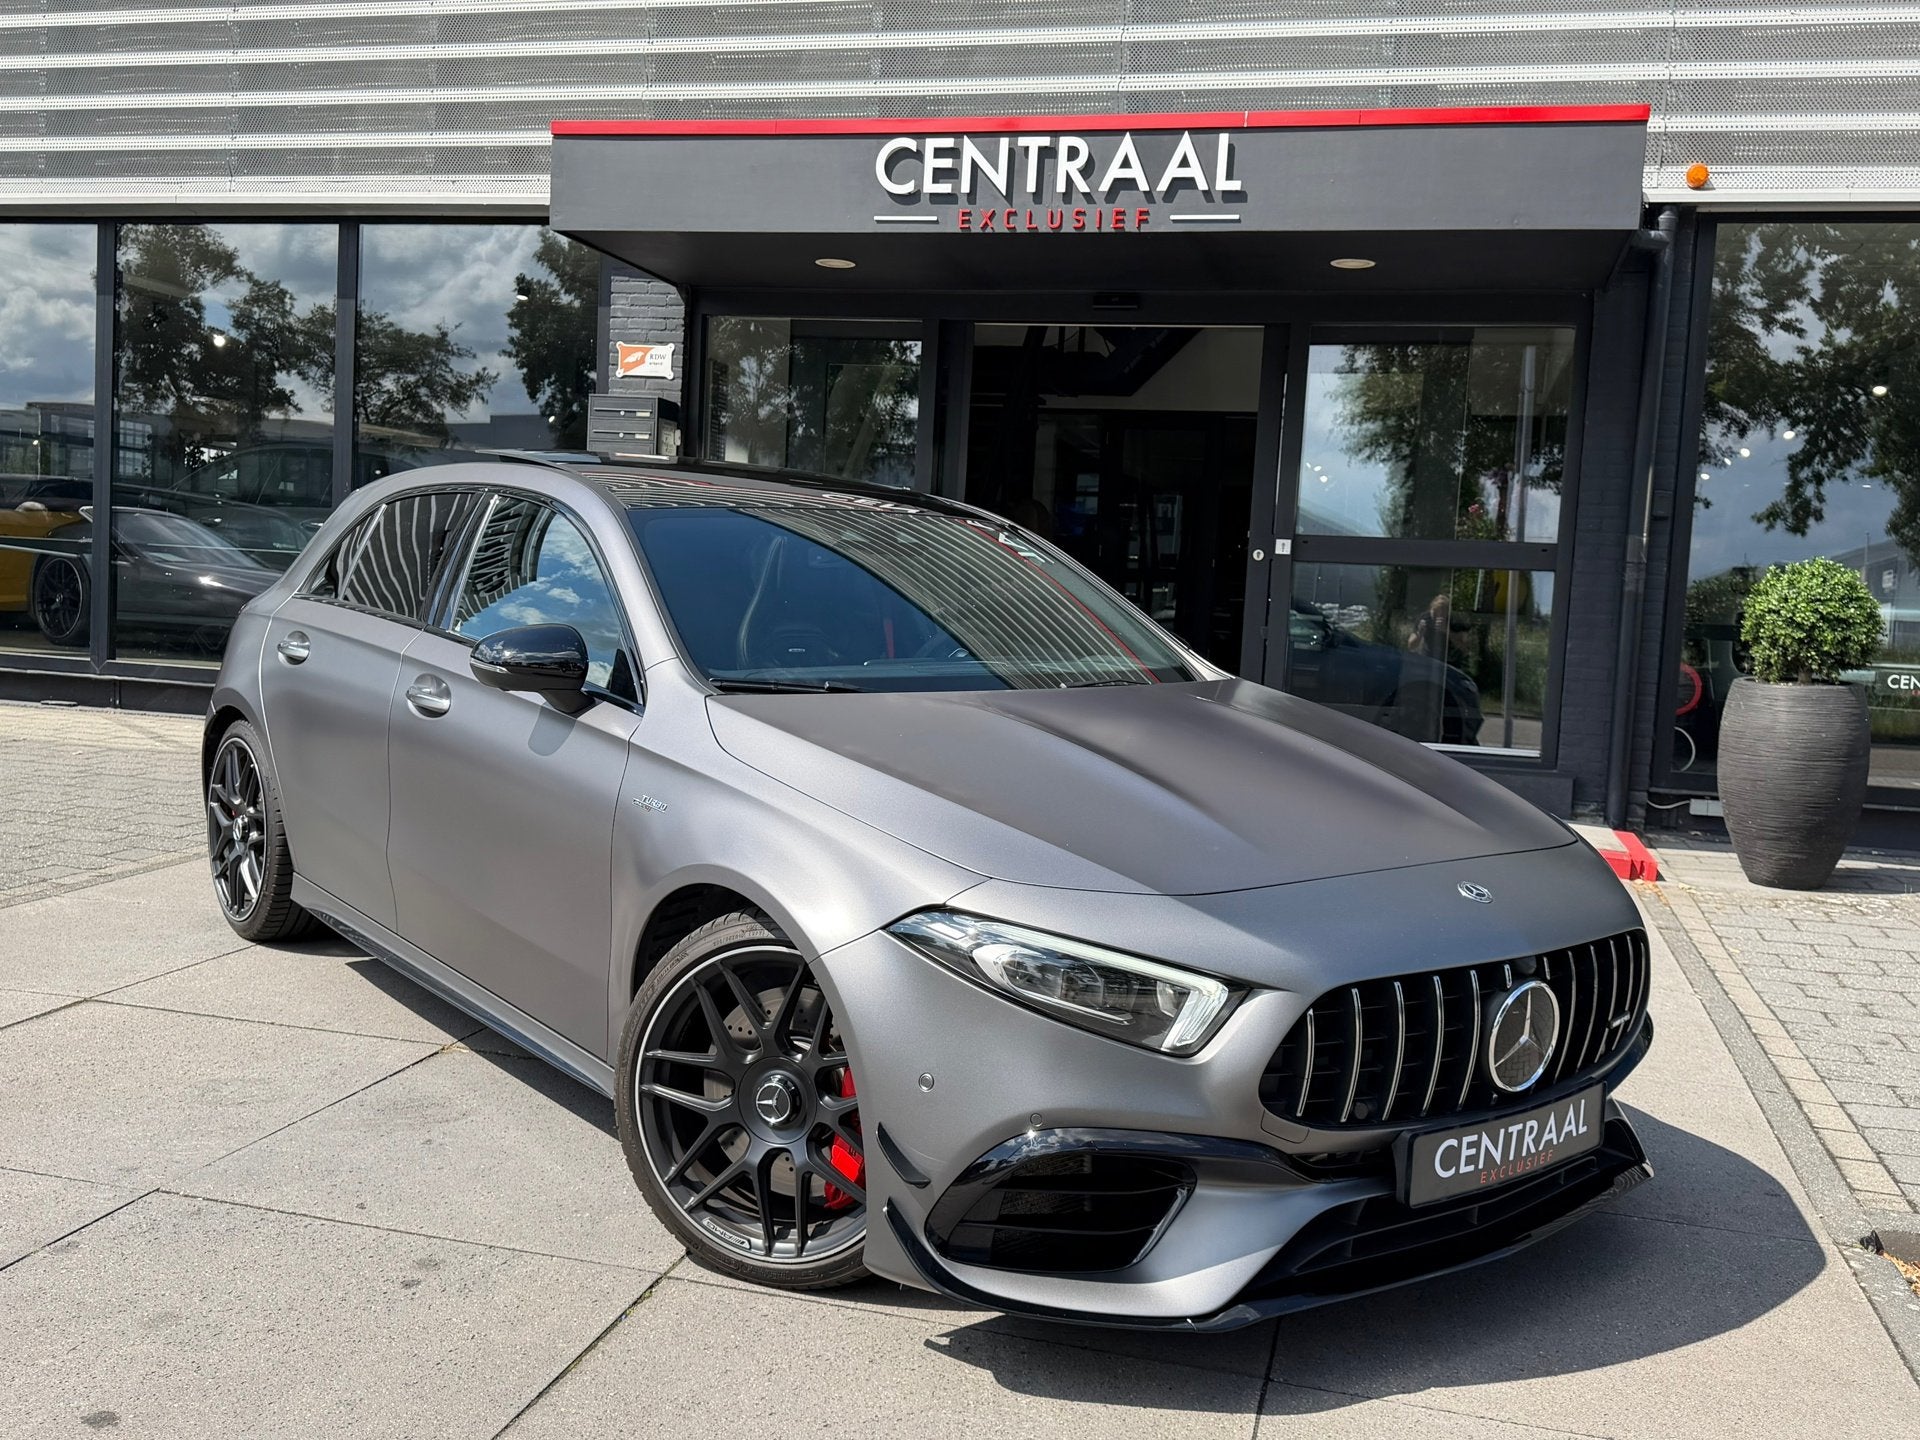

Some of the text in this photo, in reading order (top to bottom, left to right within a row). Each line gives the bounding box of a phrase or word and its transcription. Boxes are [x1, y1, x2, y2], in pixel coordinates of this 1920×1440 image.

[875, 130, 1242, 197] CENTRAAL
[957, 207, 1151, 230] EXCLUSIEF
[641, 794, 668, 811] TURBO
[1434, 1099, 1588, 1178] CENTRAAL
[1480, 1150, 1554, 1184] EXCLUSIEF
